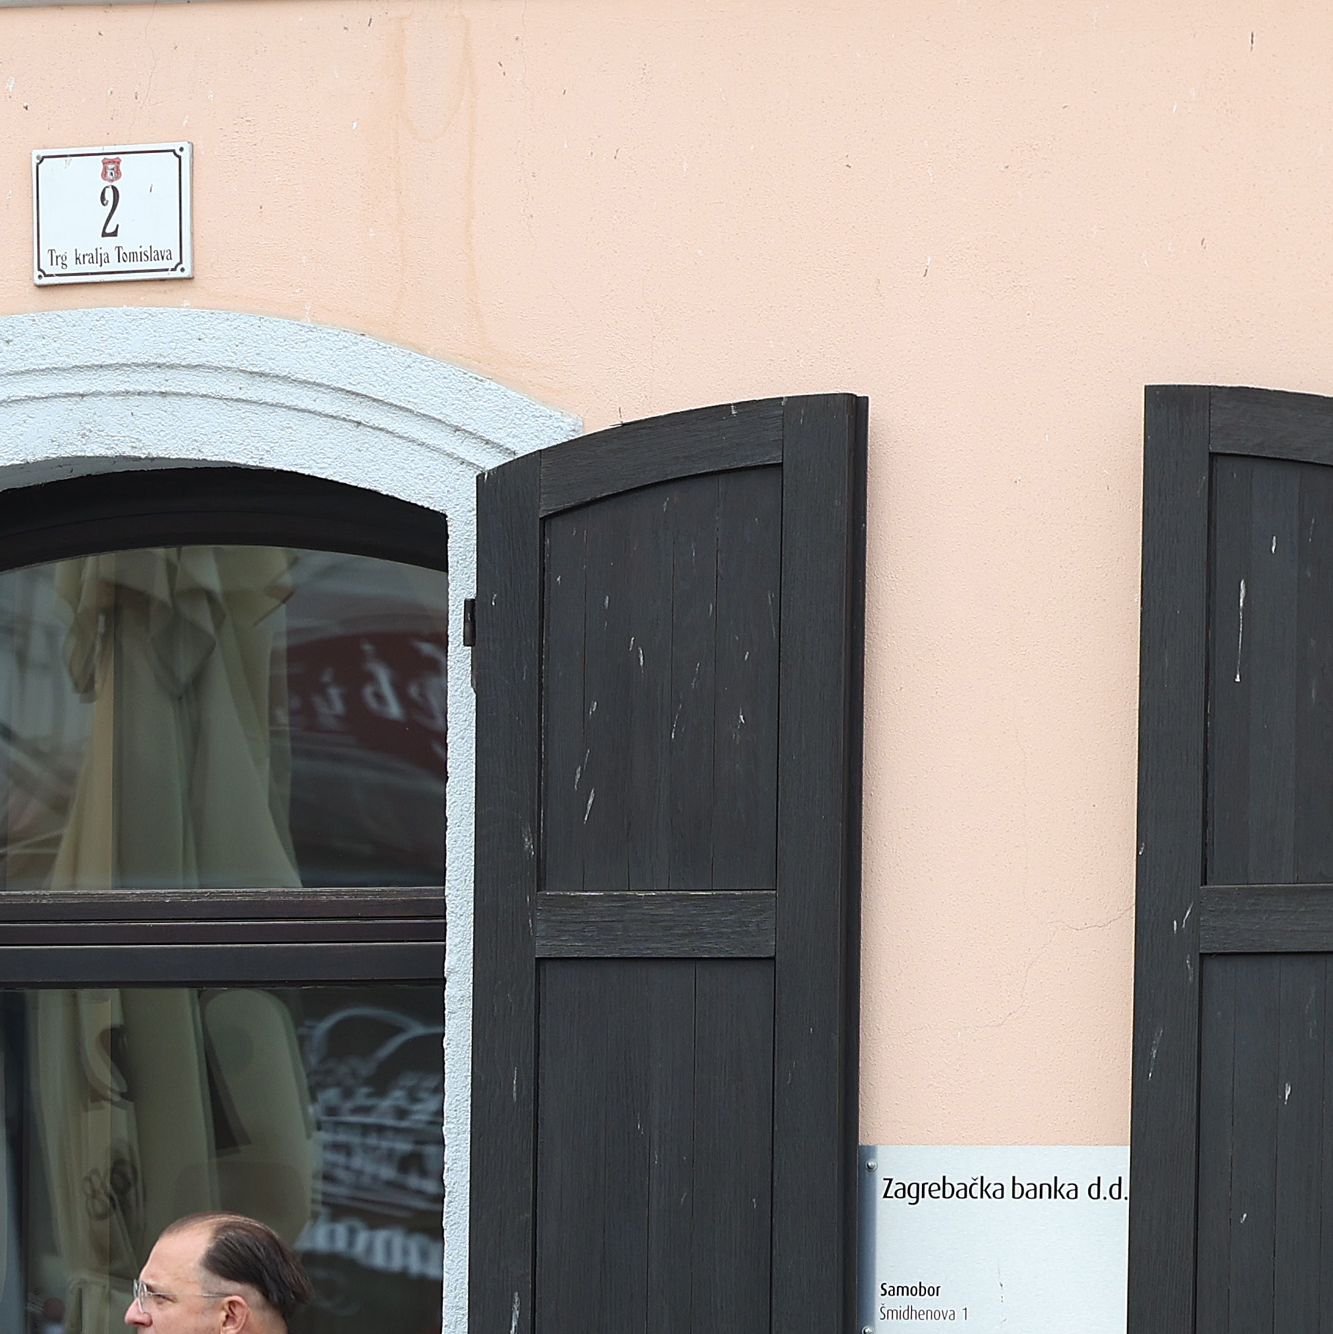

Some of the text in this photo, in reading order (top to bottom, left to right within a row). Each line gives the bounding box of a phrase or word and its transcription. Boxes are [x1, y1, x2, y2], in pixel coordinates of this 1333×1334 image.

[99, 184, 121, 238] 2
[47, 244, 173, 270] Trg kralja Tomislava
[881, 1175, 1129, 1205] Zagrebačka banka d.d.
[880, 1281, 942, 1298] Samobor
[879, 1303, 969, 1321] Šmidhenova 1
